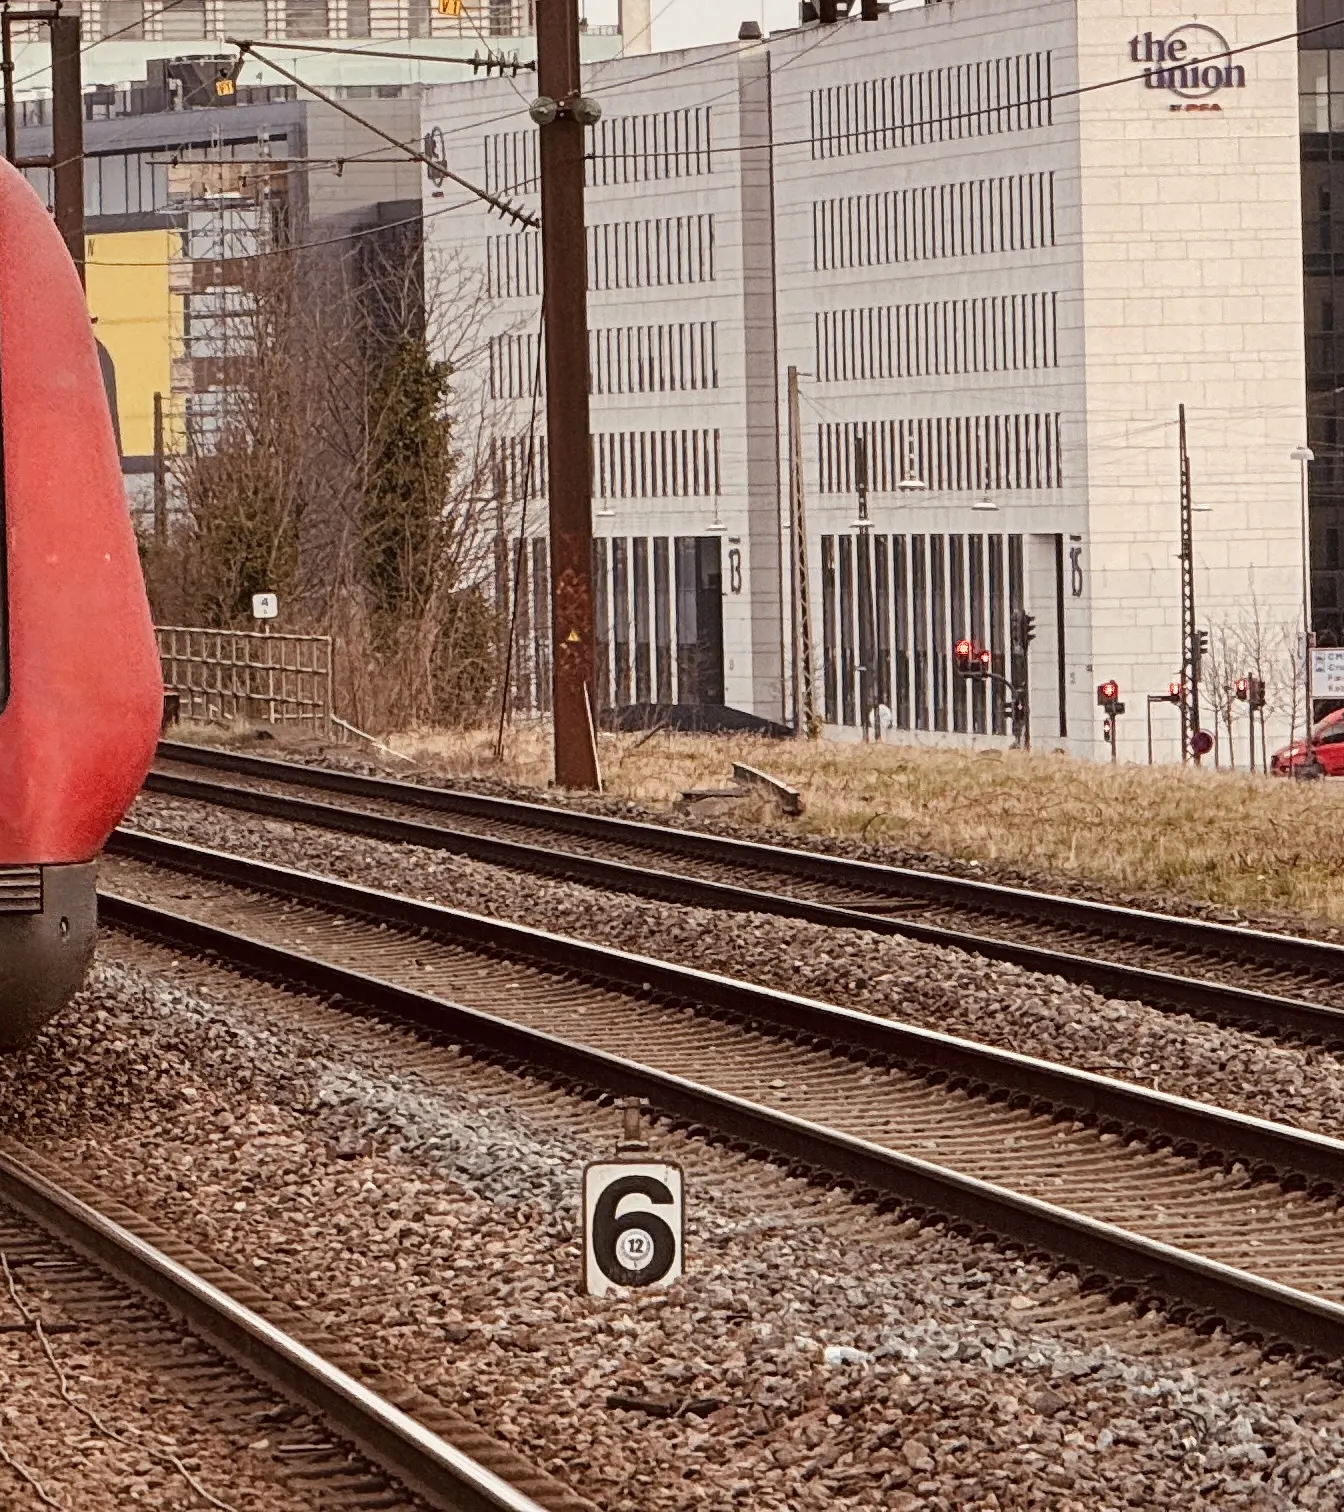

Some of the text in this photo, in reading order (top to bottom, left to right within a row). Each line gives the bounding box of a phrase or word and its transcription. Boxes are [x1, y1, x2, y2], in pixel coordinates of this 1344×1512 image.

[1128, 31, 1187, 62] the
[1143, 57, 1247, 89] union
[592, 1174, 676, 1287] 6
[627, 1238, 644, 1254] 12
